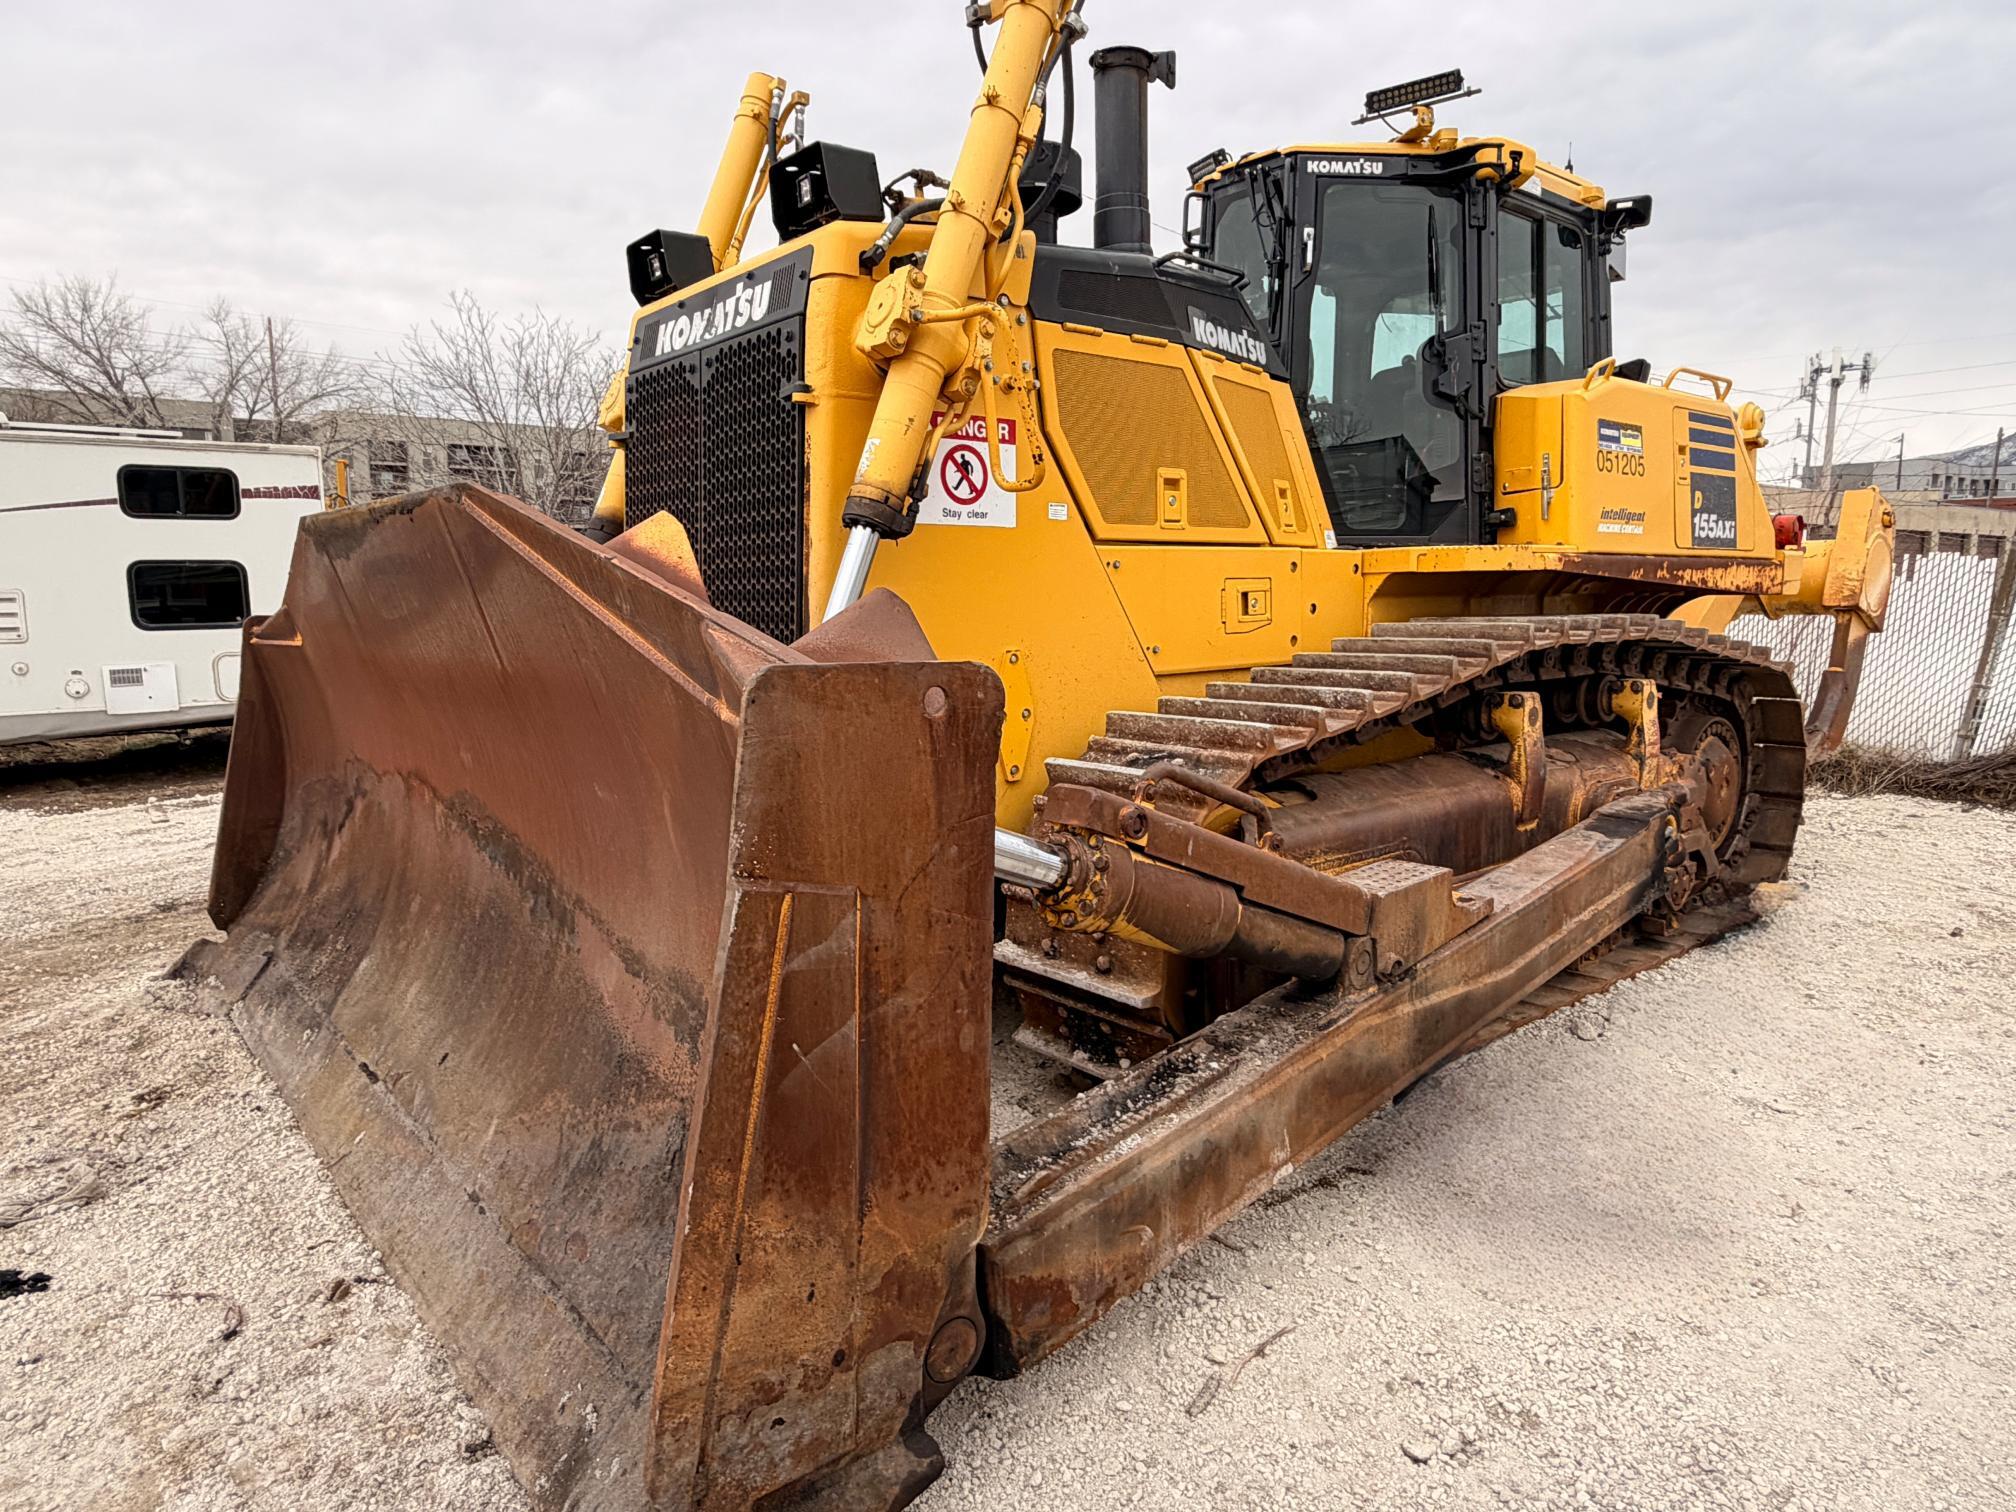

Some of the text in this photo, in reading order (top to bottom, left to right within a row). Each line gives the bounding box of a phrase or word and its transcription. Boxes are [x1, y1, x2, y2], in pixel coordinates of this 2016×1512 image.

[1307, 158, 1382, 174] KOMATSU
[1193, 316, 1266, 365] KOMATSU
[937, 416, 1009, 440] NGR
[1597, 450, 1645, 476] 051205
[1694, 491, 1703, 509] D
[942, 507, 989, 520] Stay clear
[1600, 506, 1646, 524] intelligent
[1693, 512, 1735, 538] 155AXi
